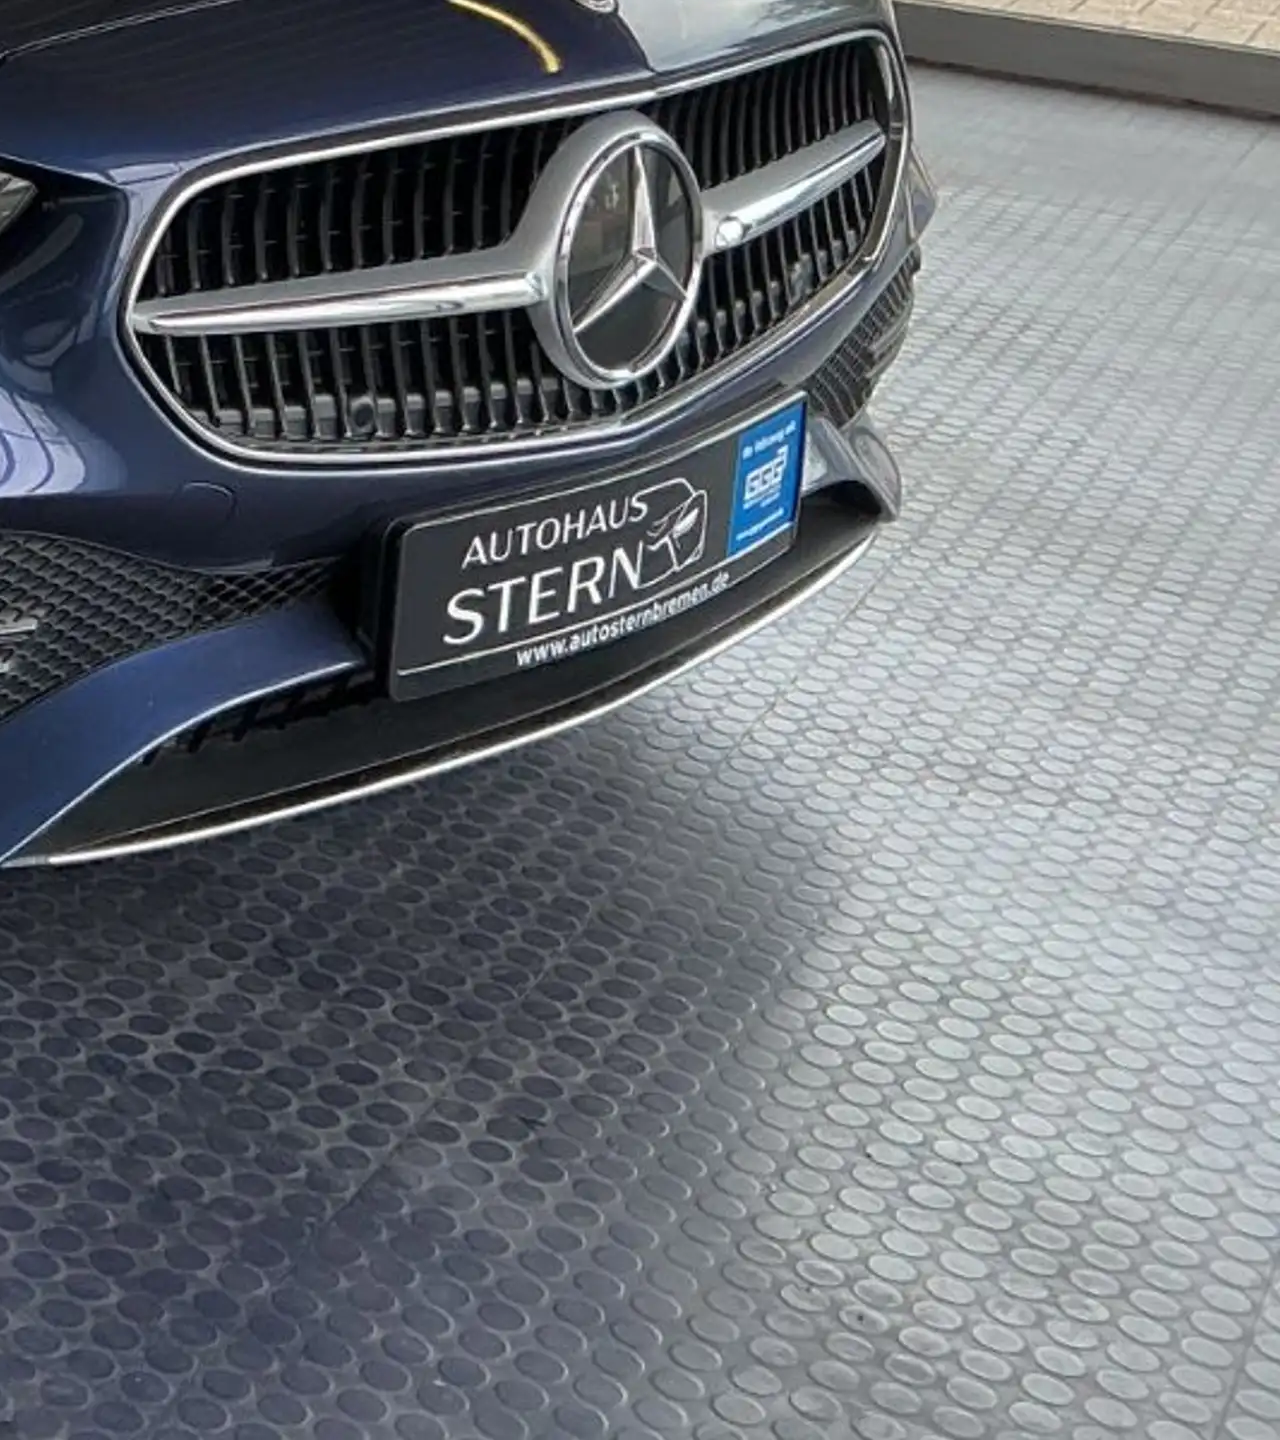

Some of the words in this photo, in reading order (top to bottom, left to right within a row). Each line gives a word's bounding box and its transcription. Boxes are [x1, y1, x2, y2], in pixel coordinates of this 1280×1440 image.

[461, 493, 649, 570] AUTOHAUS
[442, 539, 644, 646] STERN
[515, 570, 731, 668] www.autosternbremen.de
